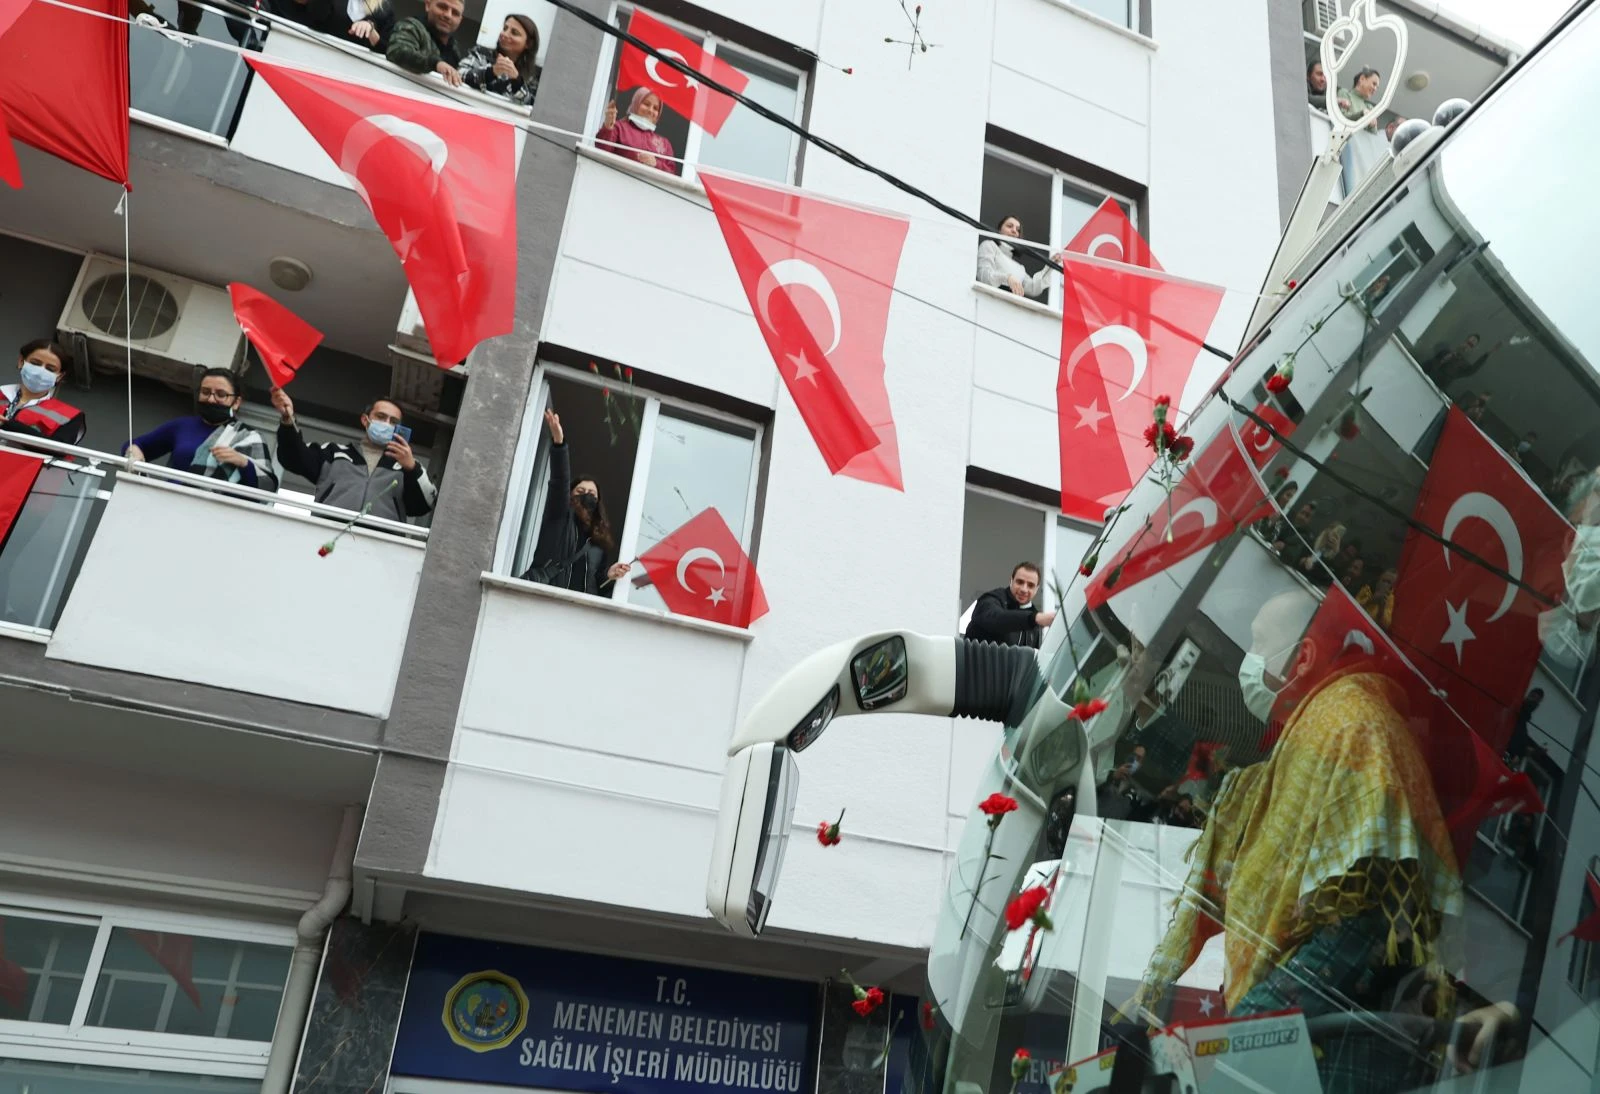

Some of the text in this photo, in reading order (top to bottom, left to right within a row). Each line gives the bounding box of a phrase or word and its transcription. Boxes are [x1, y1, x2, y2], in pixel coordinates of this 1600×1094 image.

[656, 976, 691, 1006] T.C.
[553, 1001, 782, 1053] MENEMEN BELEDİYESİ
[519, 1035, 801, 1092] SAĞLIK İŞLERİ MÜDÜRLÜĞÜ
